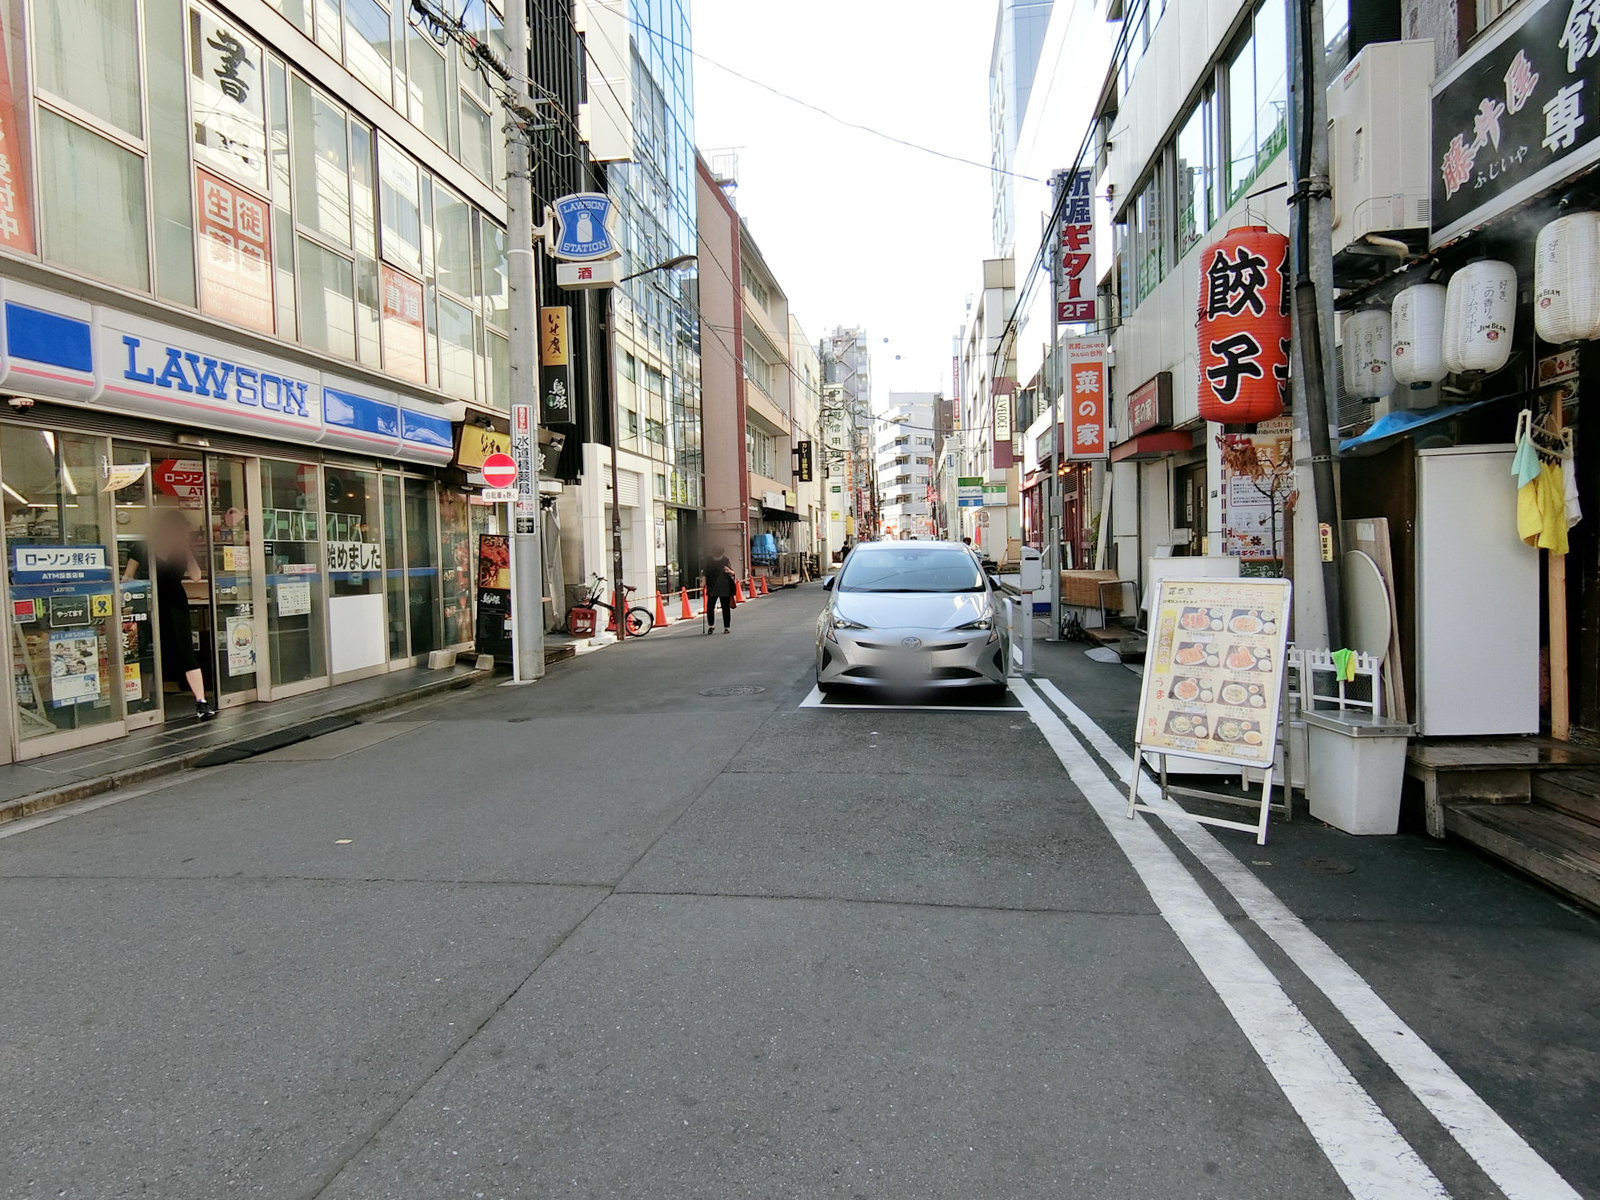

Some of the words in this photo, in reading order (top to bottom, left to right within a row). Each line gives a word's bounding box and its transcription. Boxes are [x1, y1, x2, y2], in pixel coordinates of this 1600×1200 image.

[1473, 145, 1528, 189] ふじいや
[206, 184, 262, 238] 生徒
[562, 200, 606, 213] LAWSON
[563, 239, 608, 253] STATION
[1056, 171, 1092, 299] 新堀ギター
[577, 266, 592, 280] 酒
[385, 285, 420, 320] 書道
[1063, 303, 1088, 318] 2F
[1207, 246, 1268, 404] 餃子
[1491, 322, 1507, 334] BEAM
[122, 335, 310, 417] LAWSON
[997, 402, 1008, 430] VELOCE
[1075, 370, 1100, 447] 菜の家
[1134, 398, 1152, 428] 菜の家
[517, 436, 530, 495] 水道橋薬局
[485, 491, 516, 499] 自転車を除く
[25, 553, 97, 566] ローソン銀行
[327, 543, 381, 571] 始めました
[1204, 586, 1276, 598] ランチメニュー
[56, 609, 84, 618] やってます
[120, 613, 148, 622] 二丁目店
